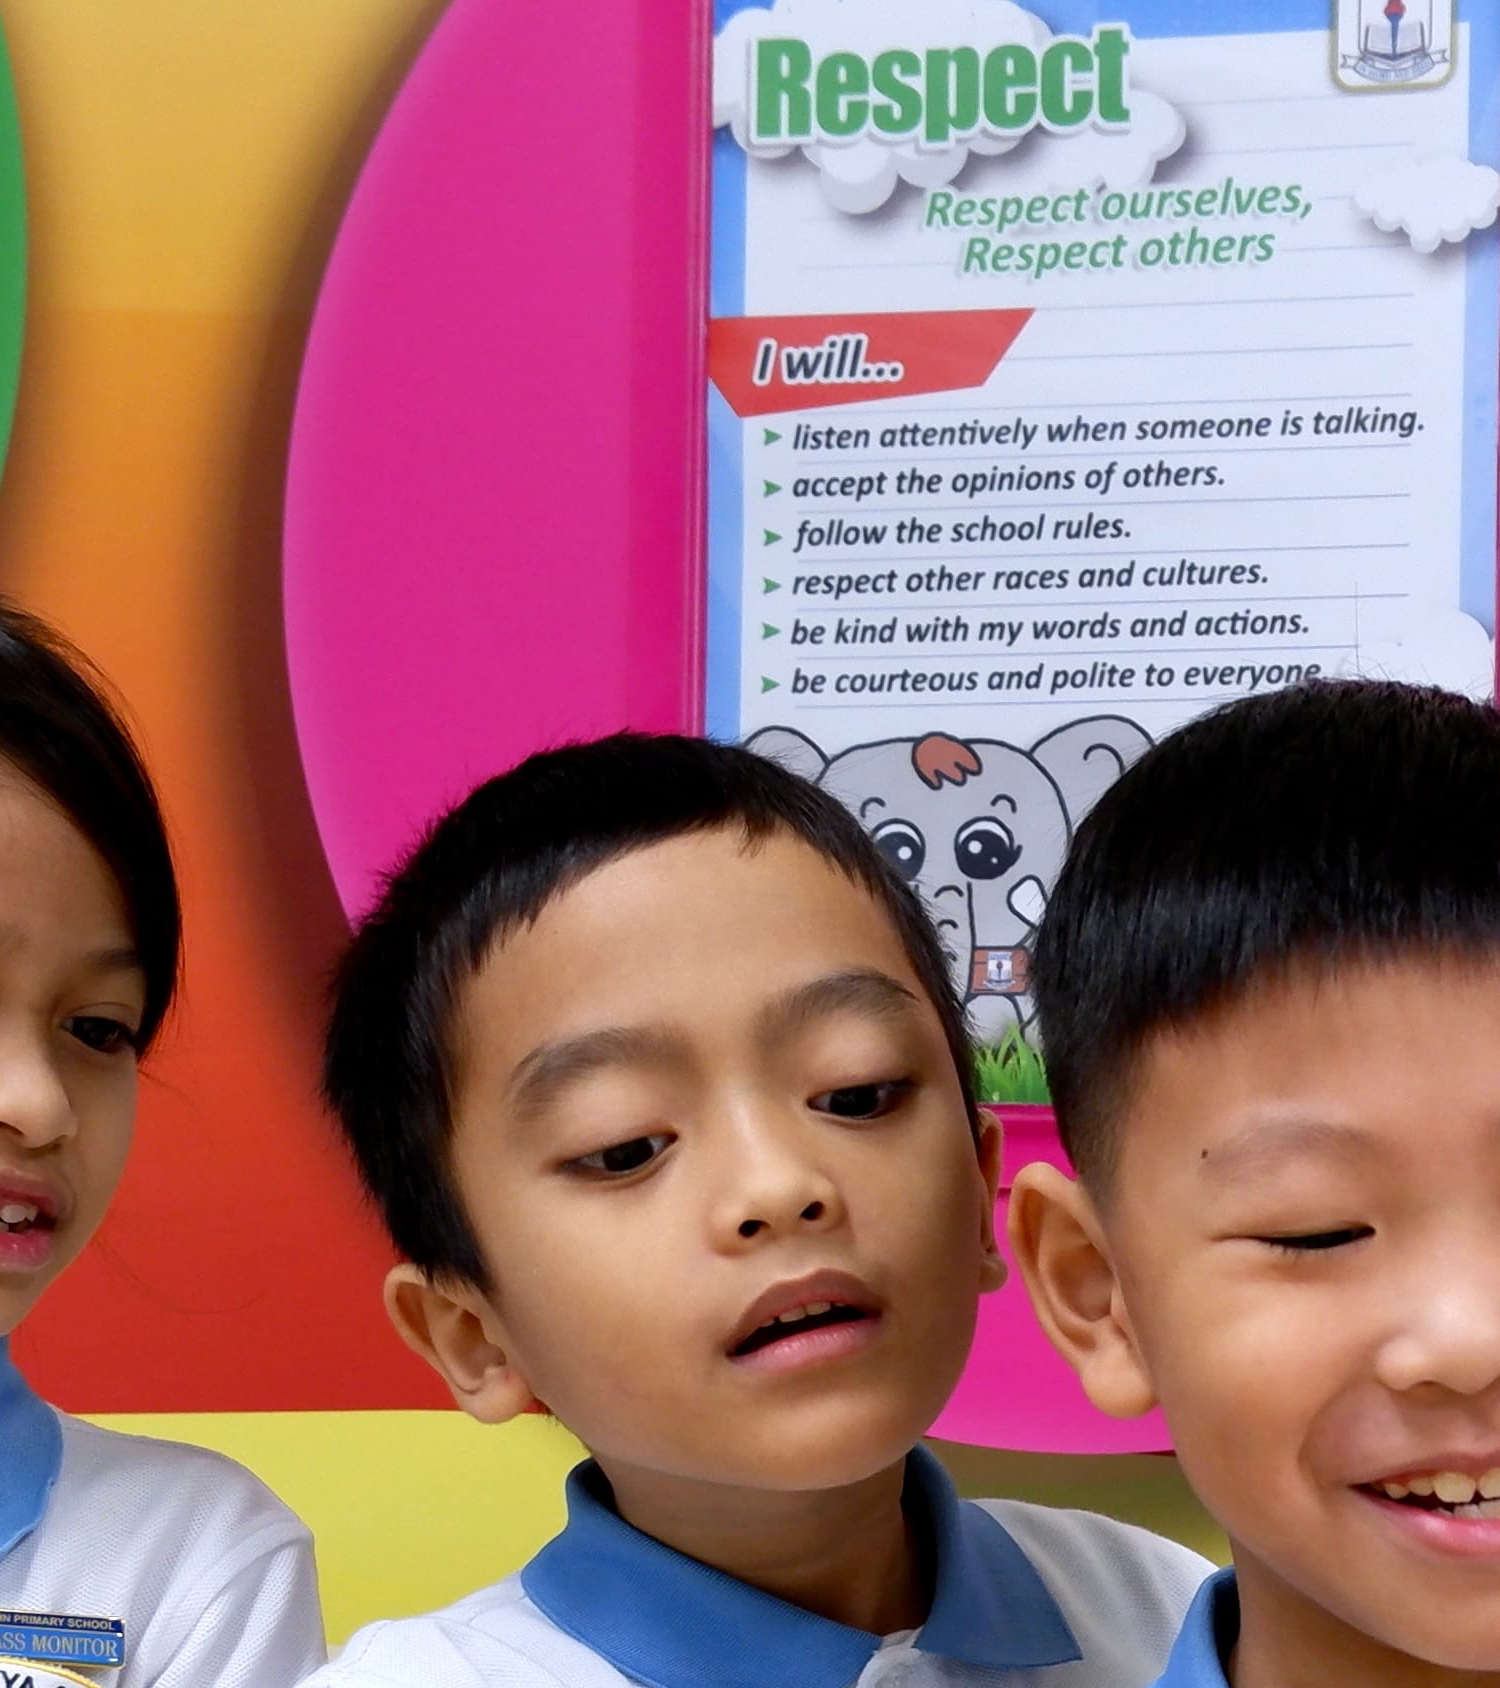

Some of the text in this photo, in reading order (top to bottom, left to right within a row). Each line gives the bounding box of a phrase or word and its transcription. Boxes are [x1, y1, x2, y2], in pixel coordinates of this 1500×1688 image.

[755, 26, 1132, 145] Respect
[925, 177, 1313, 231] Respect ourselves,
[963, 227, 1275, 279] Respect others
[756, 339, 900, 382] I will...
[792, 406, 1425, 450] listen attentively when someone is talking.
[792, 460, 1226, 502] accept the opinions of others.
[793, 512, 1132, 552] follow the school rules.
[792, 559, 1269, 600] respect other races and cultures.
[791, 609, 1310, 647] be kind with my words and actions.
[791, 661, 1321, 696] be courteous and polite to everyone
[13, 1614, 65, 1627] PRIMARY
[67, 1618, 116, 1631] SCHOOL
[32, 1634, 118, 1658] MONITOR
